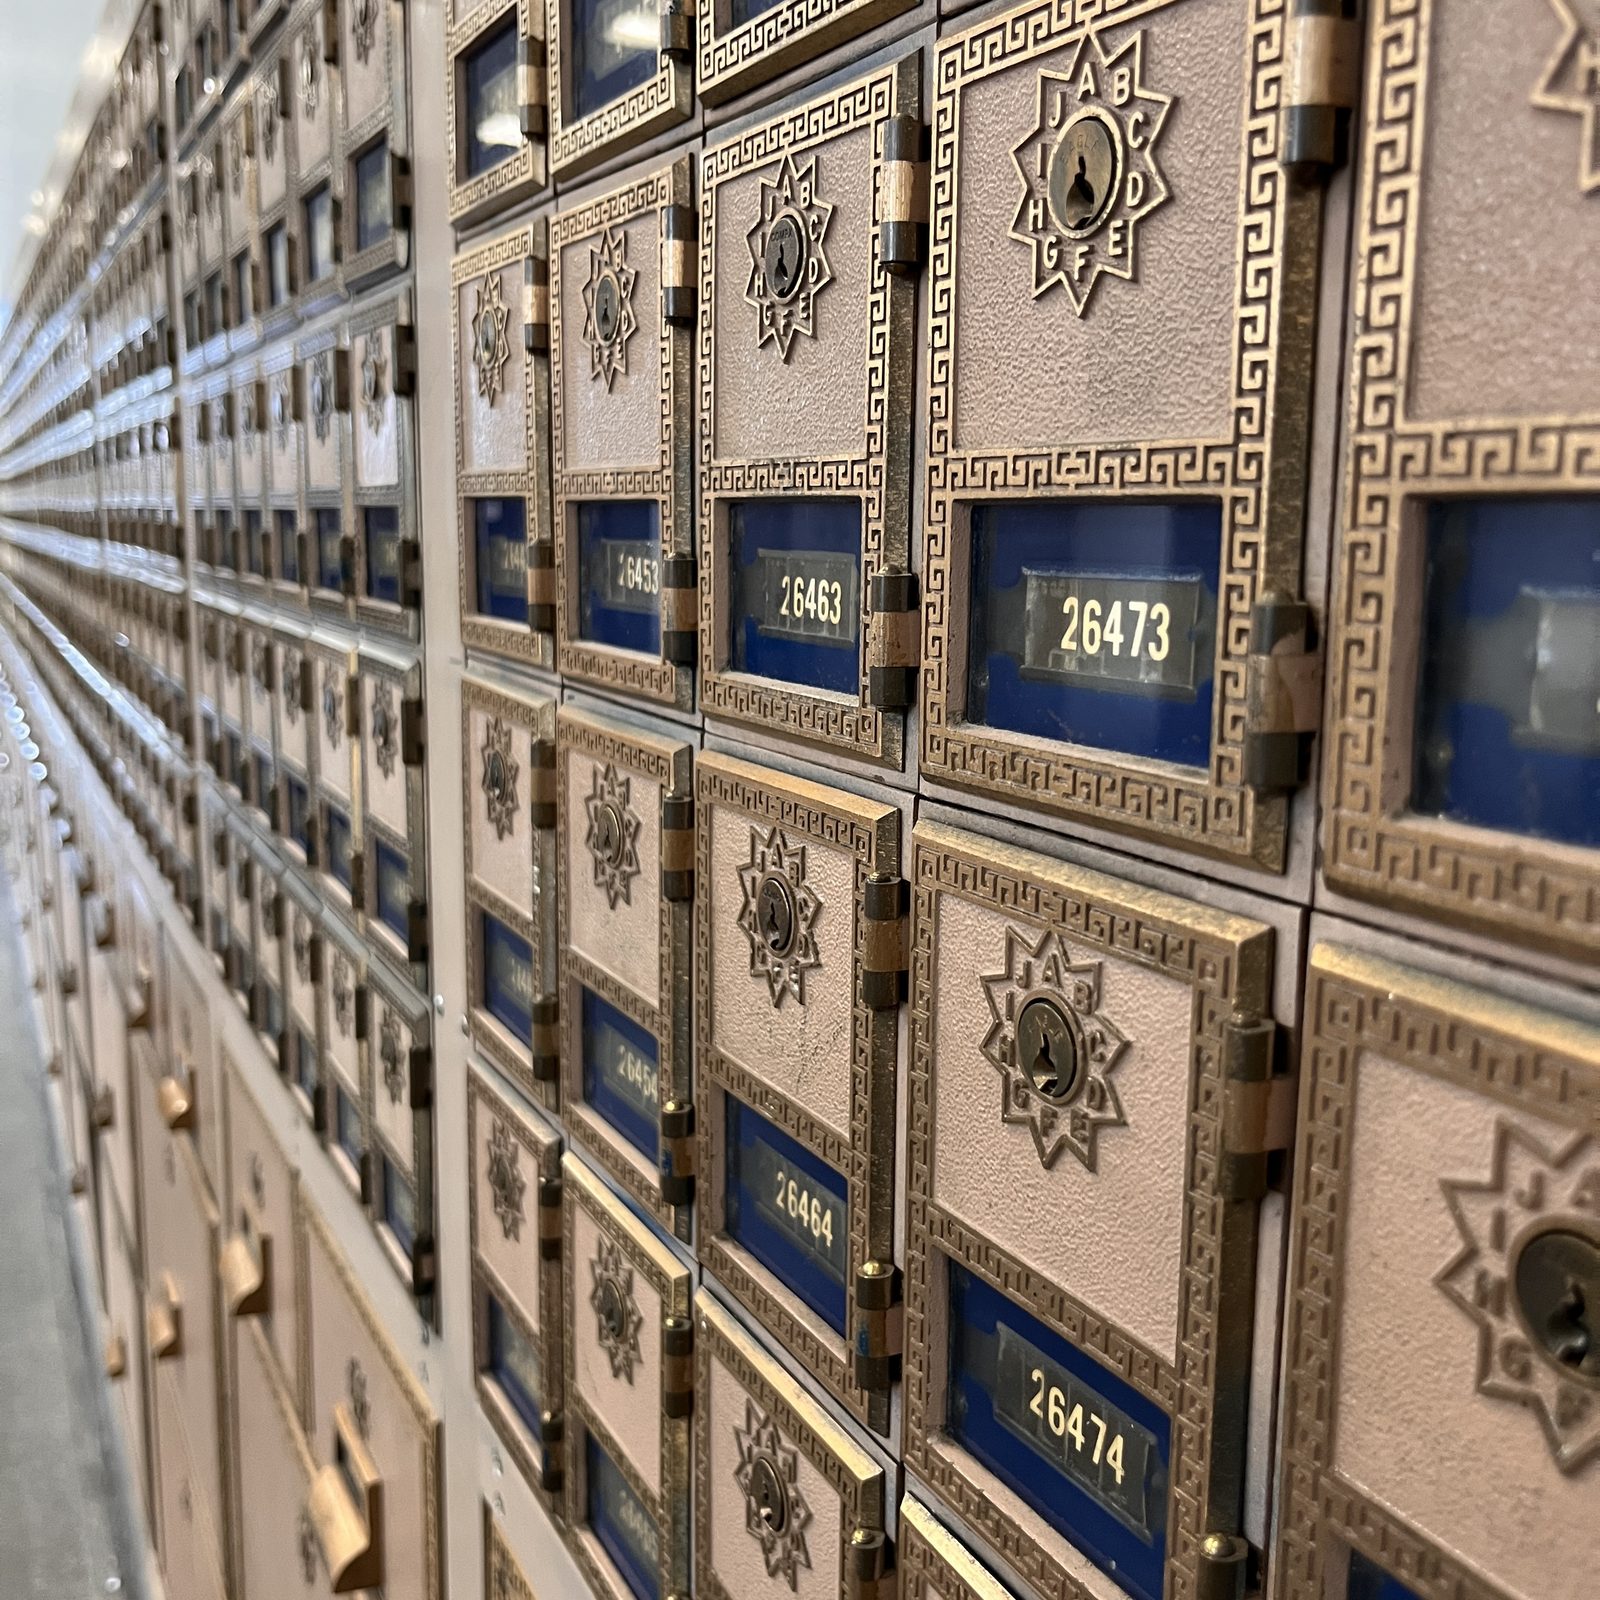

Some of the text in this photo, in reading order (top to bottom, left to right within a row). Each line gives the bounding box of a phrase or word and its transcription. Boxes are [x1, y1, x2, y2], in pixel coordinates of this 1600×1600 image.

[1077, 62, 1096, 100] A
[1113, 67, 1131, 106] B
[1048, 91, 1062, 127] J
[1128, 111, 1144, 149] C
[1126, 171, 1144, 207] D
[1028, 199, 1044, 232] H
[1043, 235, 1058, 269] G
[1108, 220, 1124, 256] E
[1074, 245, 1090, 281] F
[618, 553, 659, 595] 26453
[779, 575, 842, 625] 26463
[1060, 596, 1171, 662] 26473
[775, 1170, 833, 1248] 26464
[1029, 1368, 1125, 1485] 26474
